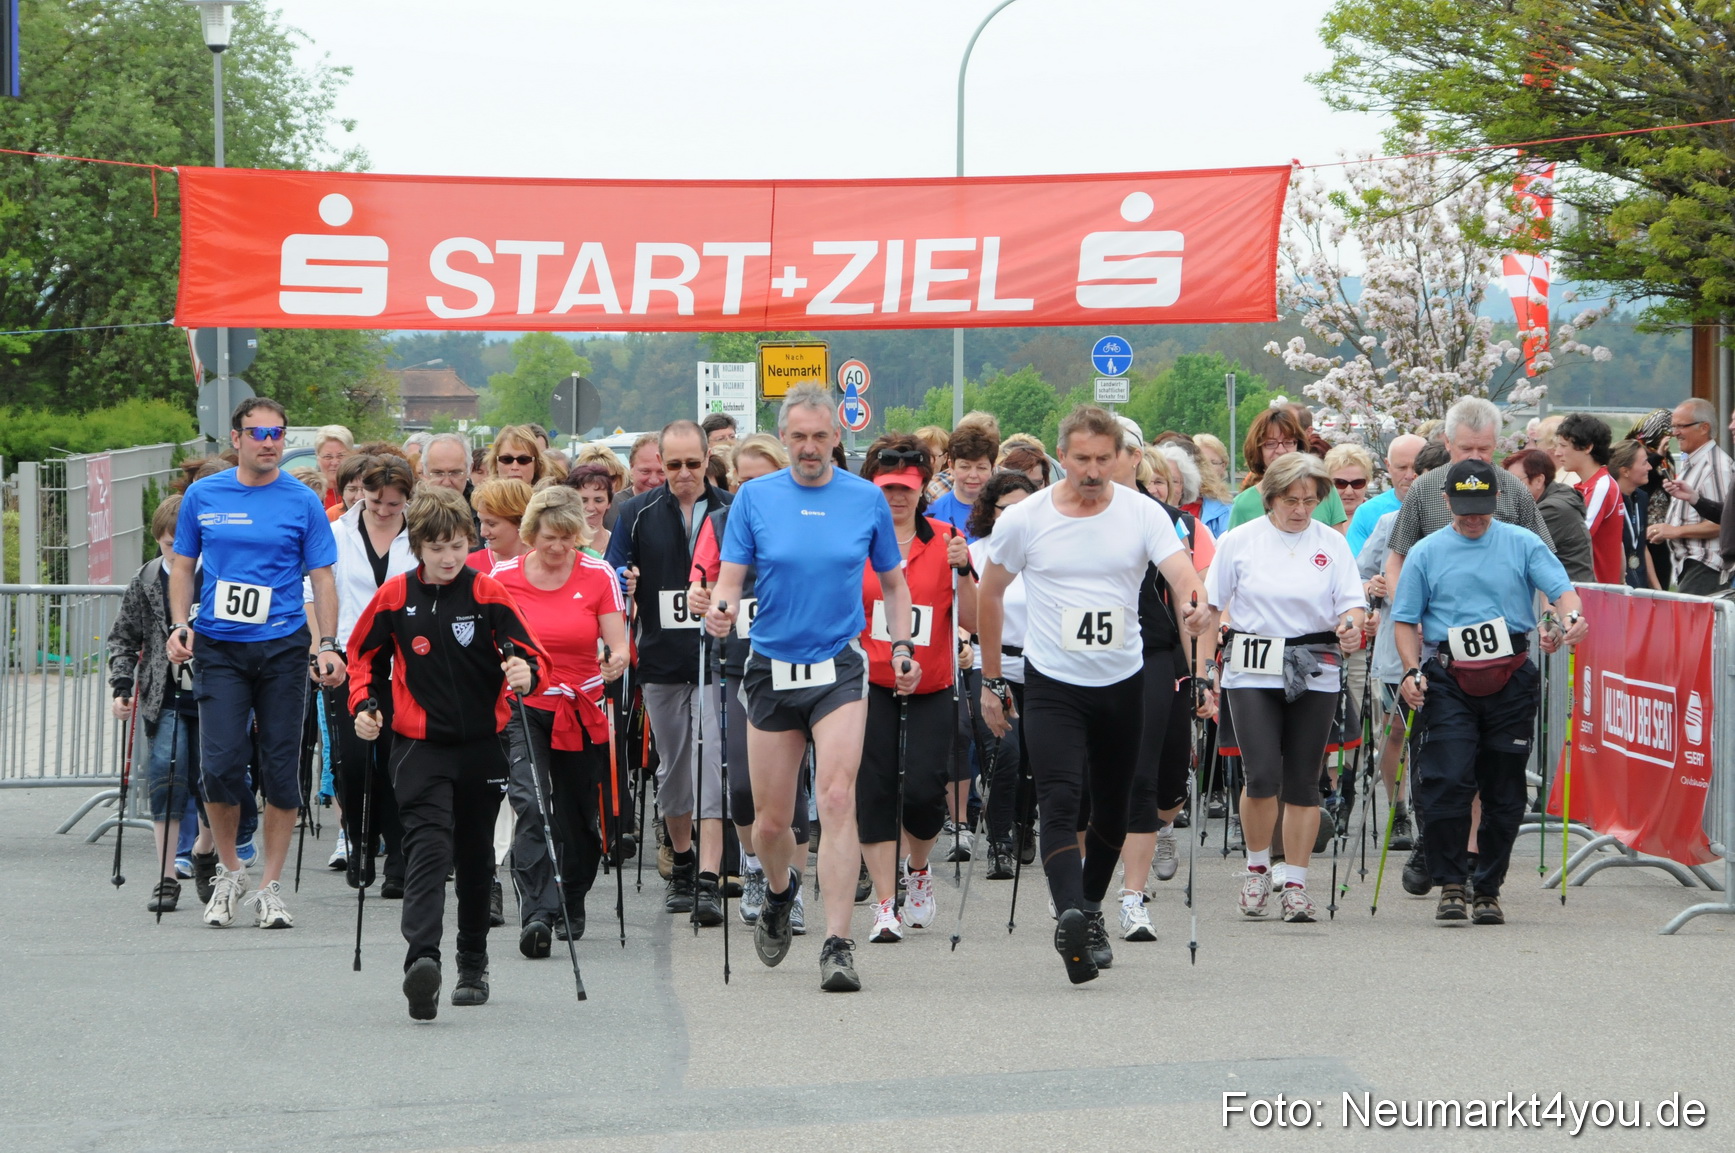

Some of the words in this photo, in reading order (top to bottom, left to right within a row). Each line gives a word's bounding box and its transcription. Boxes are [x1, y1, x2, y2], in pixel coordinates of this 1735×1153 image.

[768, 364, 822, 377] Neumarkt
[845, 370, 863, 385] 60
[226, 585, 260, 618] 50
[1077, 611, 1113, 646] 45
[1461, 623, 1499, 657] 89
[1242, 638, 1272, 669] 117
[1637, 696, 1651, 747] BEI
[1652, 698, 1673, 752] SEAT
[1684, 751, 1705, 767] SEAT
